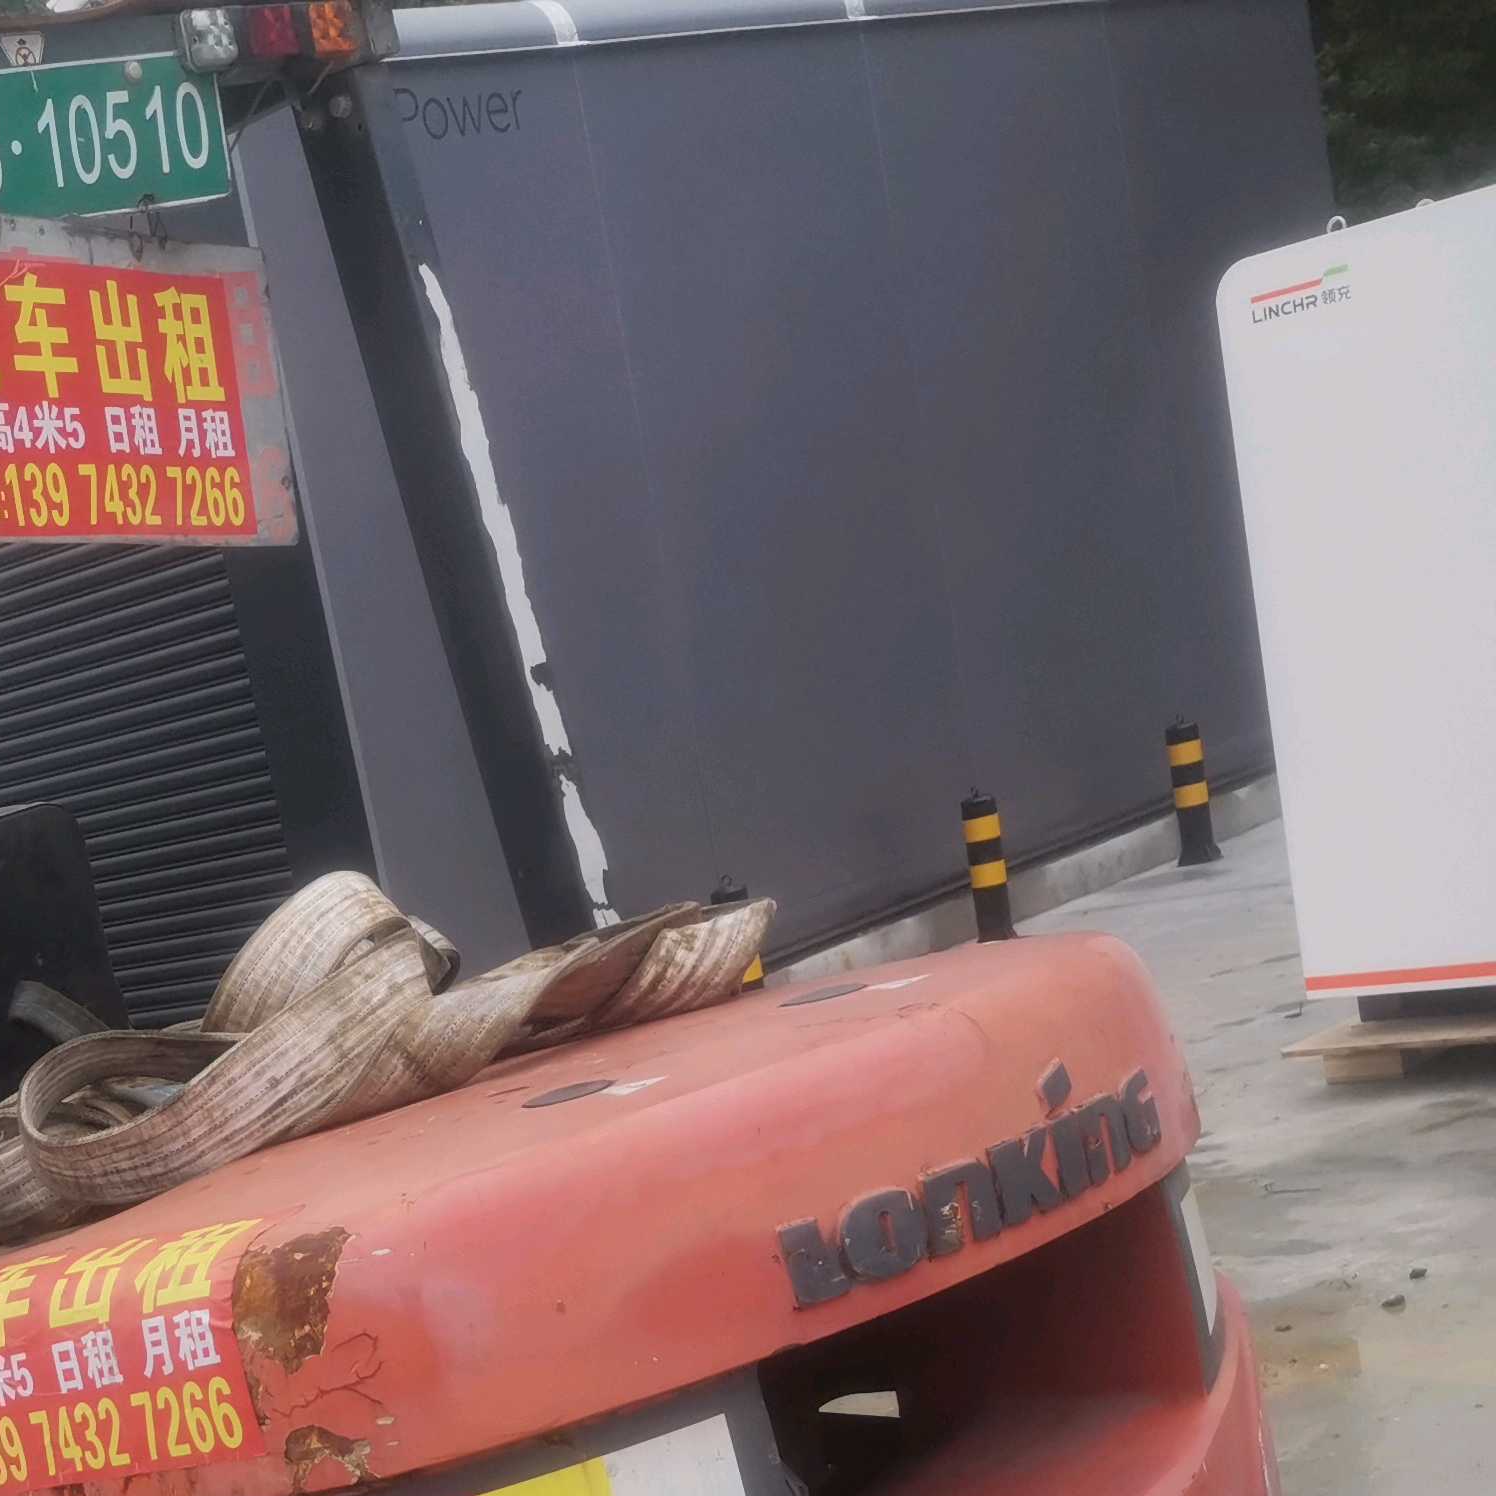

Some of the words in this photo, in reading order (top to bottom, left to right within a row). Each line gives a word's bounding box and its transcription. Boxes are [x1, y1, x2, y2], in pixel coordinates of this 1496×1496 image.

[392, 87, 523, 140] Power
[1251, 294, 1318, 324] LINCHR
[1321, 285, 1352, 306] 领充
[104, 404, 163, 456] 日租
[177, 406, 236, 458] 月租
[78, 463, 162, 526] 7432
[167, 466, 246, 527] 7266
[51, 1329, 124, 1394] 日租
[141, 1308, 222, 1379] 月租
[29, 1397, 131, 1477] 7432
[131, 1376, 244, 1462] 7266
